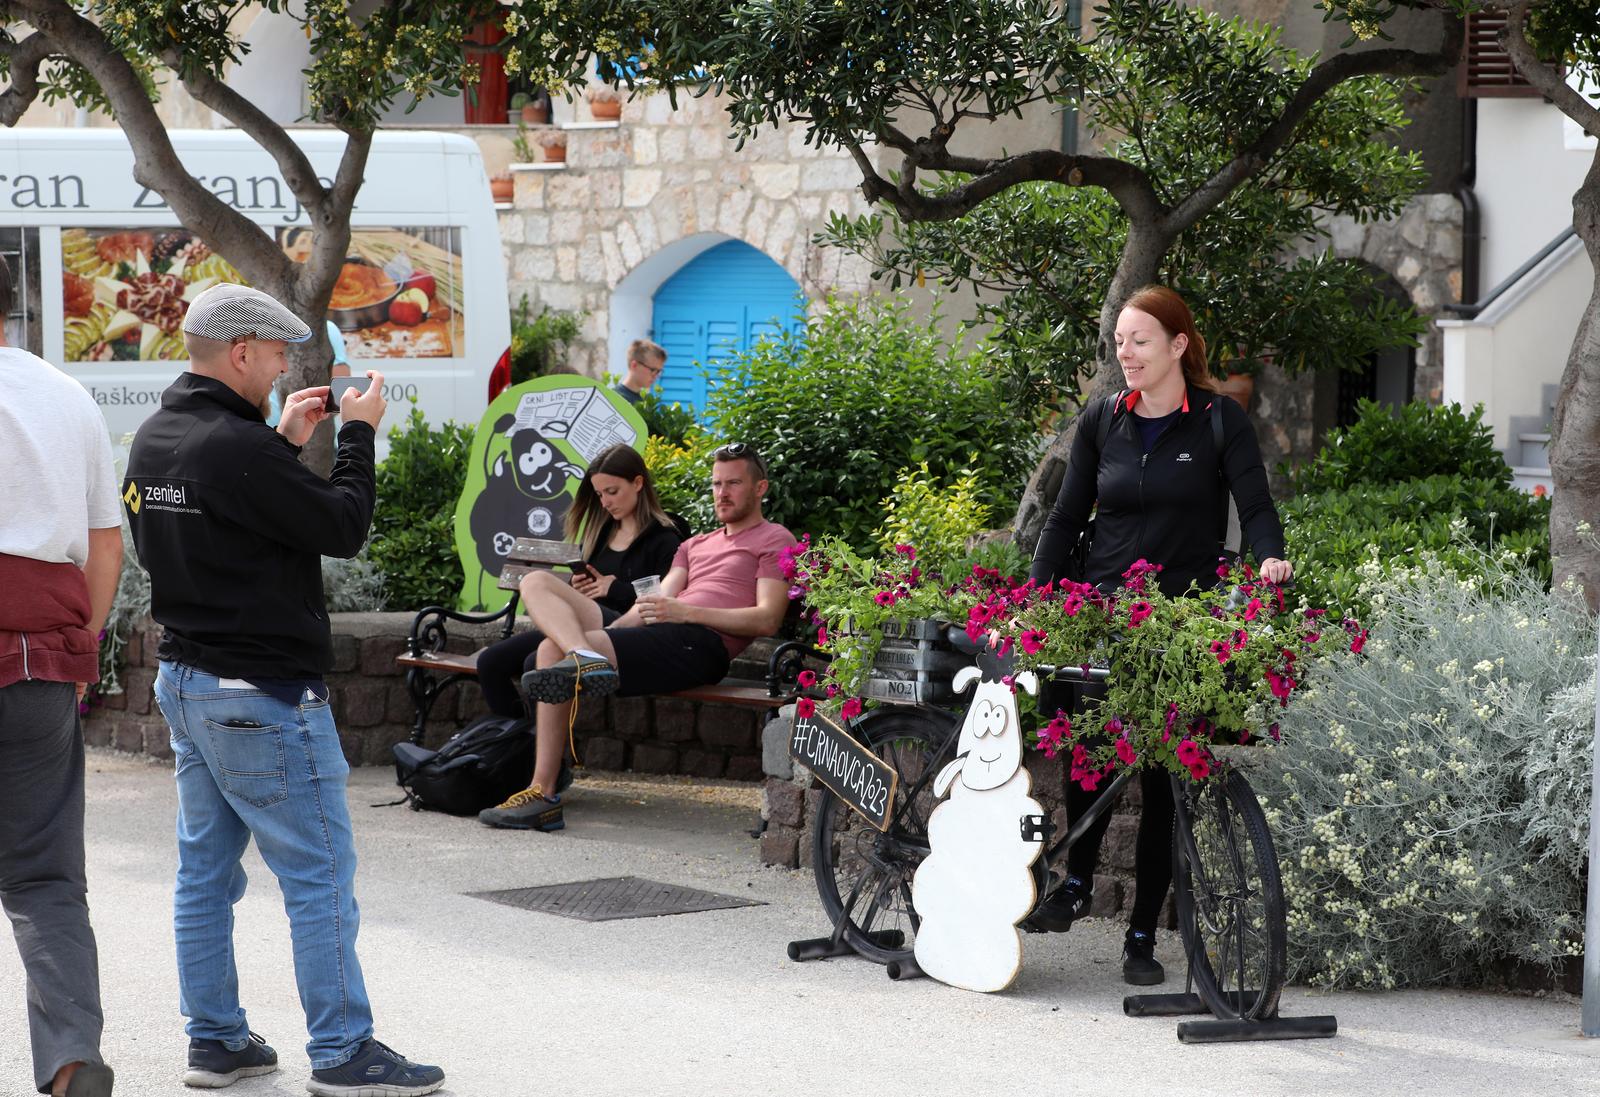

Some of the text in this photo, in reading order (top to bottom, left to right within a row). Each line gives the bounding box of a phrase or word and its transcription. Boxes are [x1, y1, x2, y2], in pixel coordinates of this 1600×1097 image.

[0, 174, 90, 208] an
[382, 383, 418, 402] 200
[145, 483, 186, 505] zenitel
[884, 623, 917, 635] FRSH
[888, 681, 913, 695] NO.2
